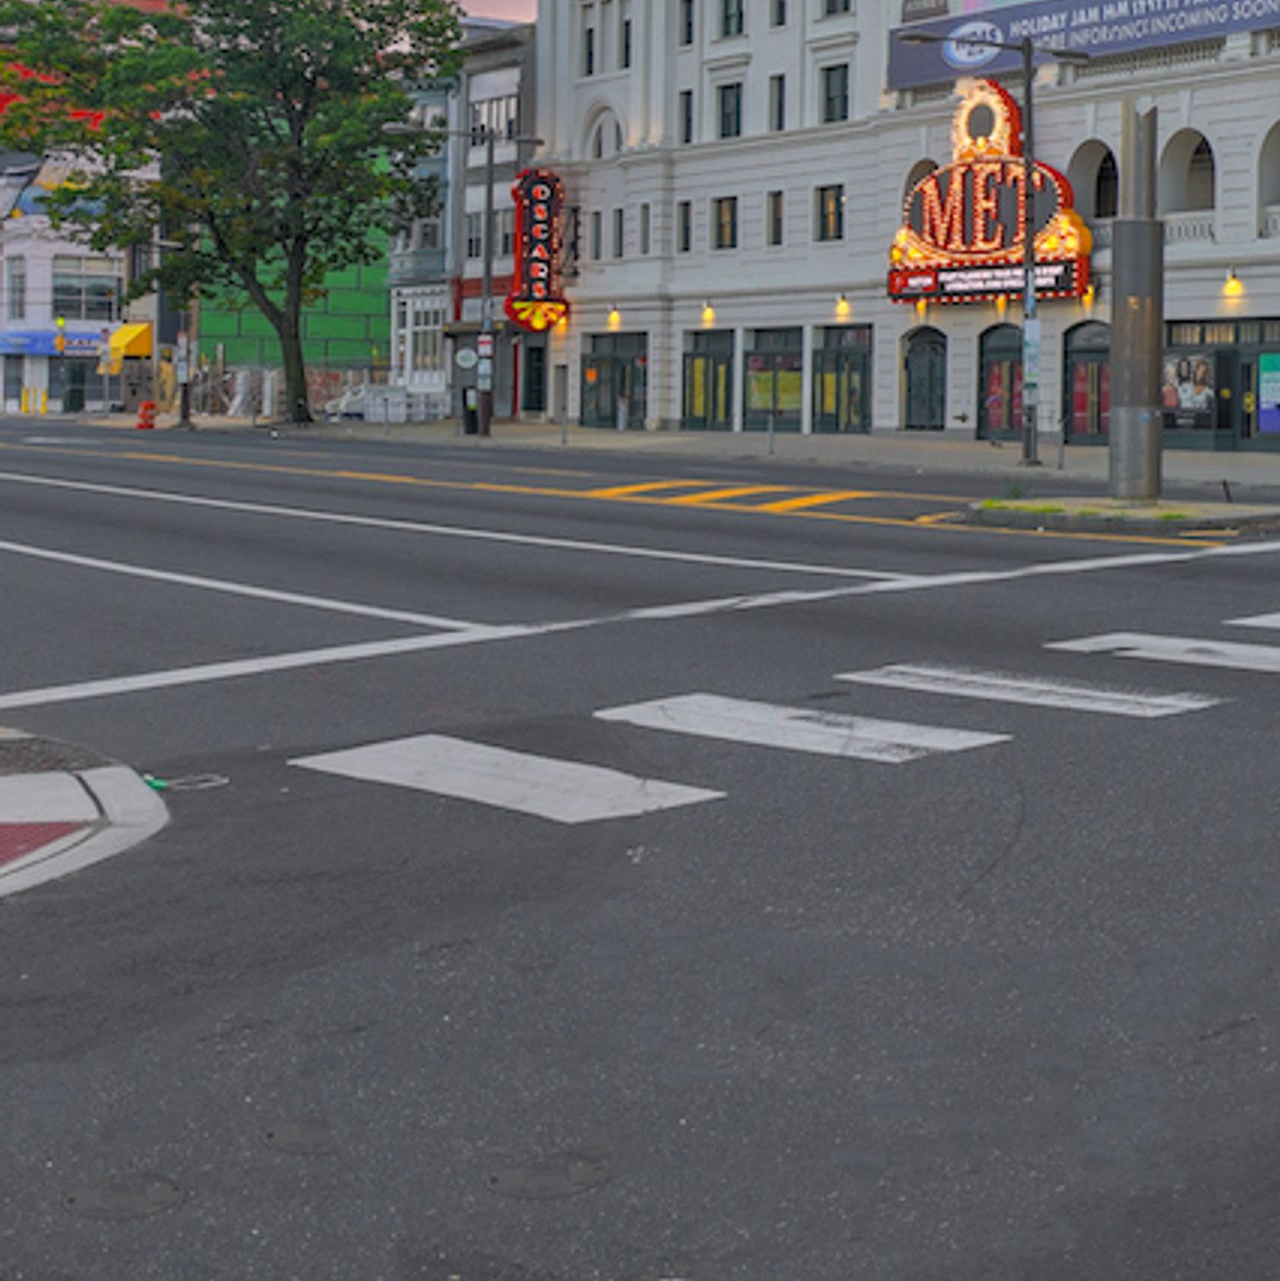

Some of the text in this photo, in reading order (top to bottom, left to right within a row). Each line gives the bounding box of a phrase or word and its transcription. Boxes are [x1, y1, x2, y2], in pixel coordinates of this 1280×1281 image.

[1009, 11, 1068, 38] HOLIDAY
[1070, 5, 1100, 28] JAM
[529, 183, 551, 300] OSCARS
[919, 159, 1044, 254] MET
